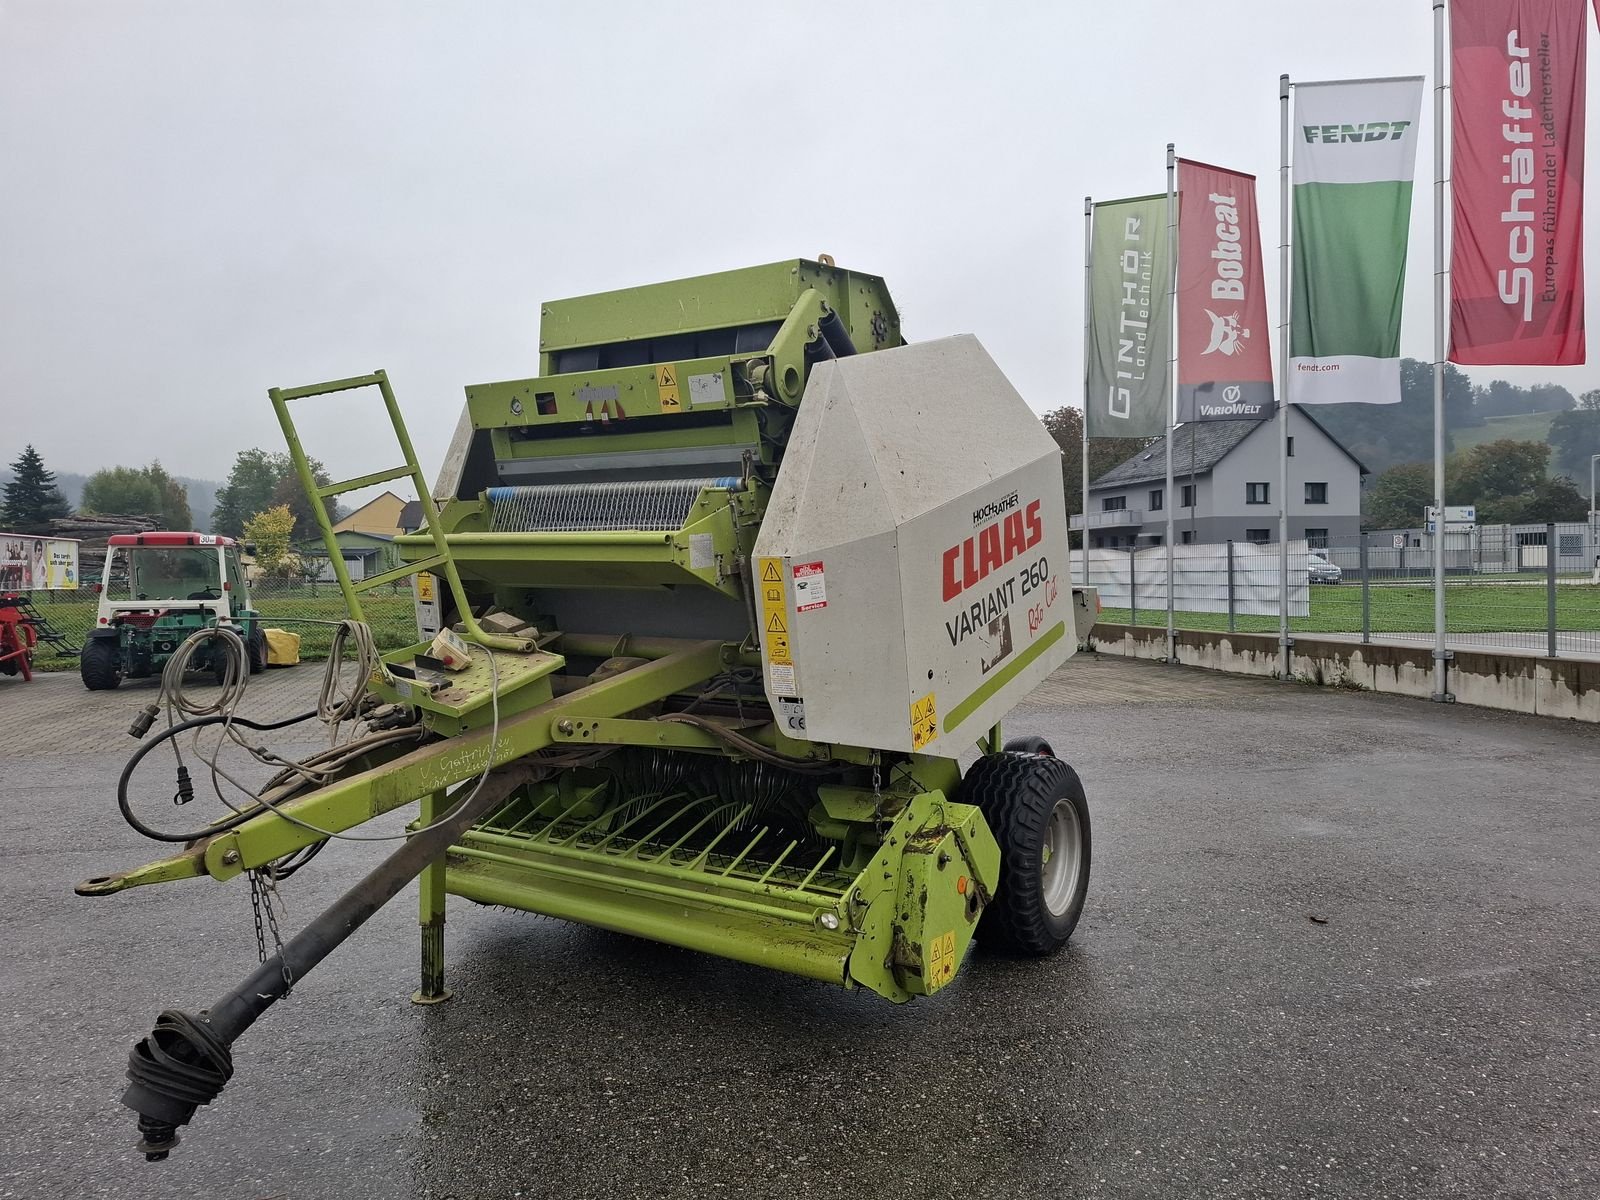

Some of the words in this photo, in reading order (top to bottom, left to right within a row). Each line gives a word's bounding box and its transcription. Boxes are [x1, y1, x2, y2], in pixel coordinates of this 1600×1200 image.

[1303, 121, 1411, 144] FENDT
[1536, 32, 1556, 148] Laderhersteller
[1498, 29, 1535, 322] Schäffer
[1541, 152, 1558, 235] führender
[1209, 193, 1245, 300] Bobcat
[1542, 237, 1559, 302] Europas
[1108, 216, 1143, 419] GINTHÖR
[1297, 363, 1340, 372] fendt.com
[942, 498, 1042, 603] CLAAS
[945, 576, 1015, 647] VARIANT
[1020, 557, 1049, 597] 260
